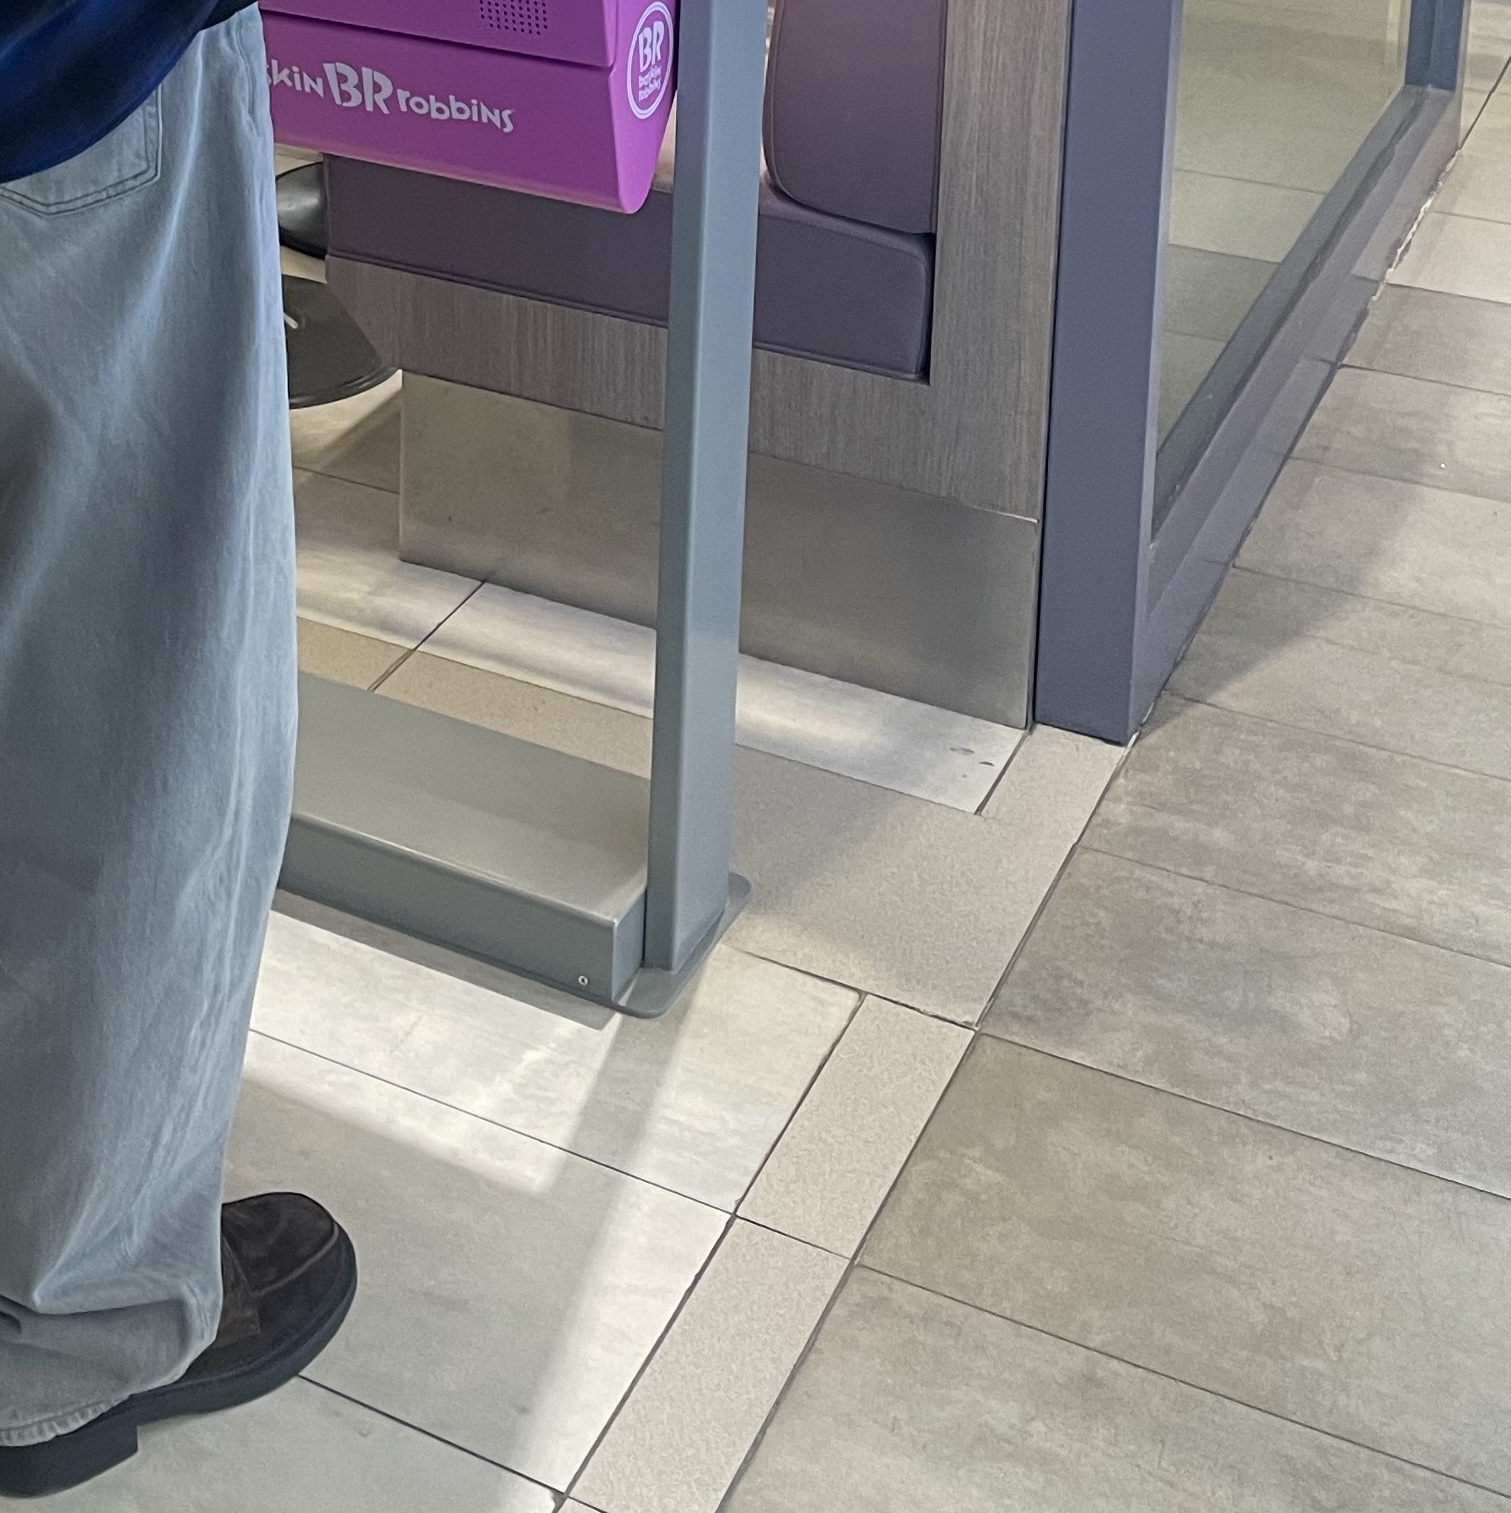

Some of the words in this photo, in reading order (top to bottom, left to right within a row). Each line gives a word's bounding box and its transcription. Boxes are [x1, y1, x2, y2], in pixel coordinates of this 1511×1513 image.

[638, 20, 665, 73] BR
[323, 61, 396, 115] BR
[396, 88, 515, 133] robbins
